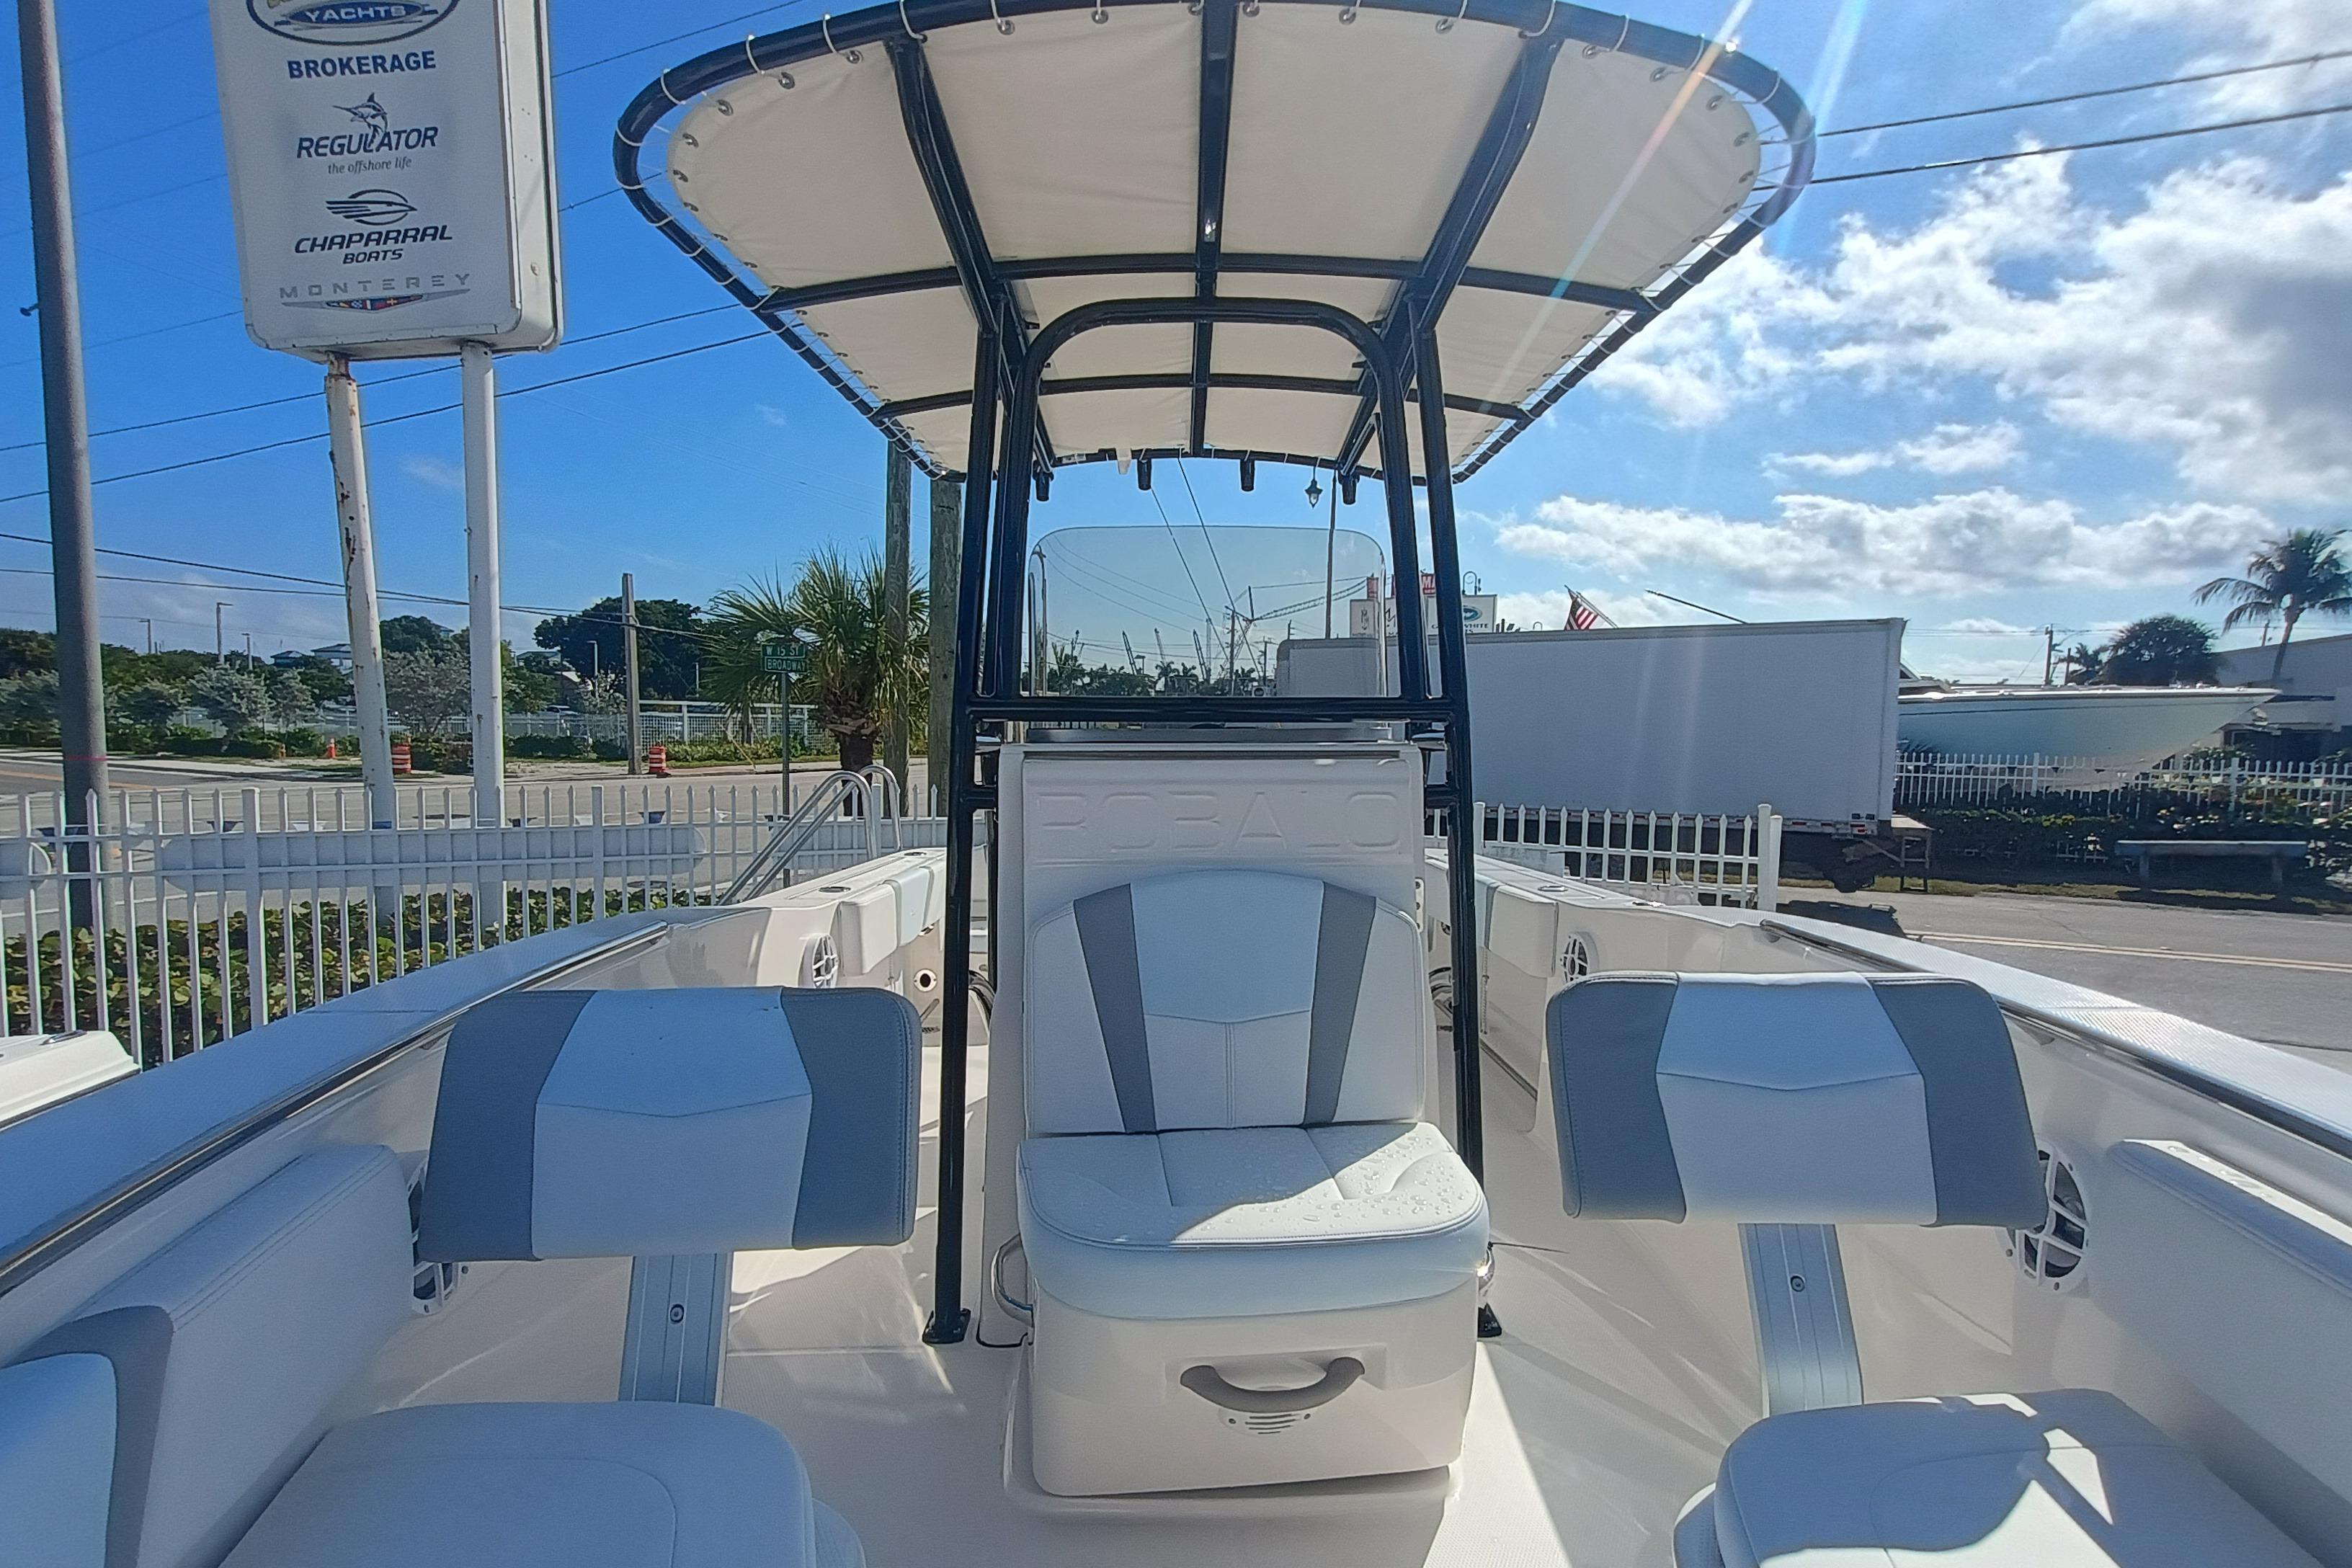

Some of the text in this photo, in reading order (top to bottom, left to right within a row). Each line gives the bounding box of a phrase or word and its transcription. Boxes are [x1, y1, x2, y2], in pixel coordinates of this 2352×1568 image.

[305, 6, 406, 22] YACHTS
[288, 50, 436, 79] BROKERAGE
[297, 126, 439, 159] REGULATOR
[328, 156, 412, 175] the offshore life
[294, 225, 453, 254] CHAPARRAL
[342, 248, 404, 264] BOATS
[279, 273, 470, 299] MONTEREY
[766, 645, 798, 656] W 15 ST
[767, 659, 806, 671] BROADWAY
